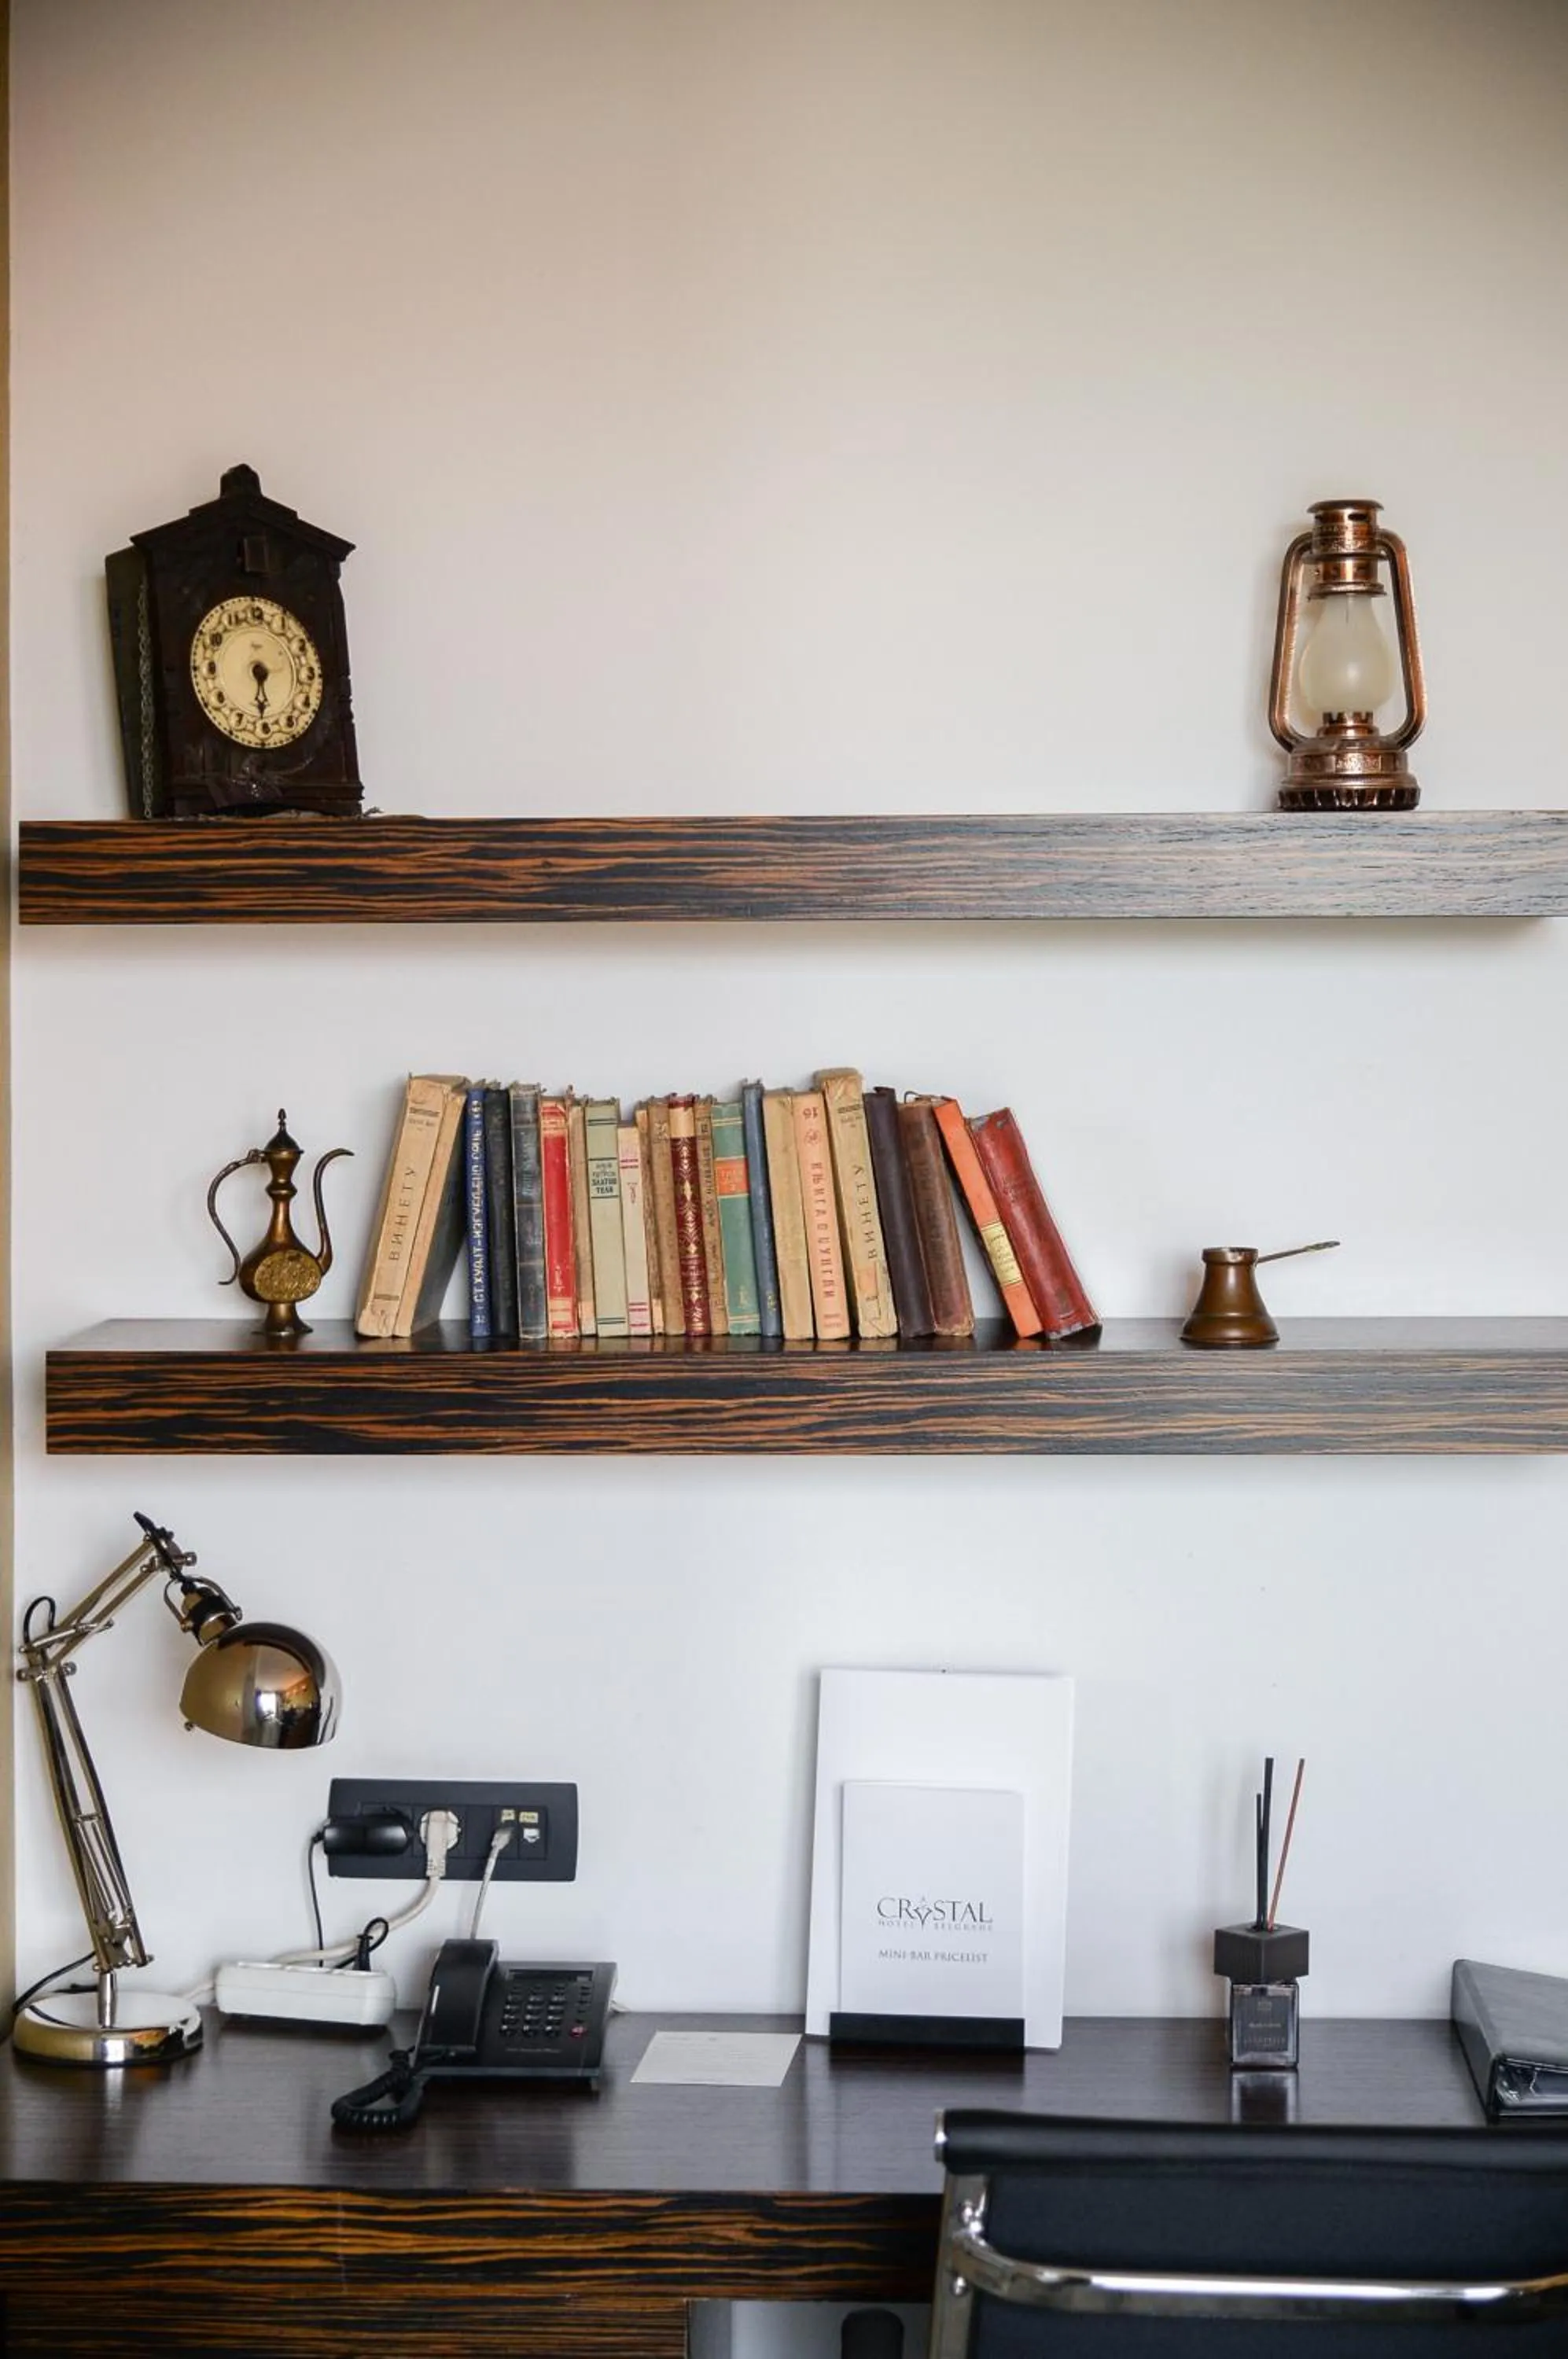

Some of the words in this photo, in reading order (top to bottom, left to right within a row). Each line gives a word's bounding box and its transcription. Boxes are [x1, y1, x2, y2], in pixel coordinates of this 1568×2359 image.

[388, 1166, 417, 1261] ВИНЕТУ
[853, 1164, 878, 1259] ВИНЕТУ
[877, 1896, 993, 1930] CRYSTAL
